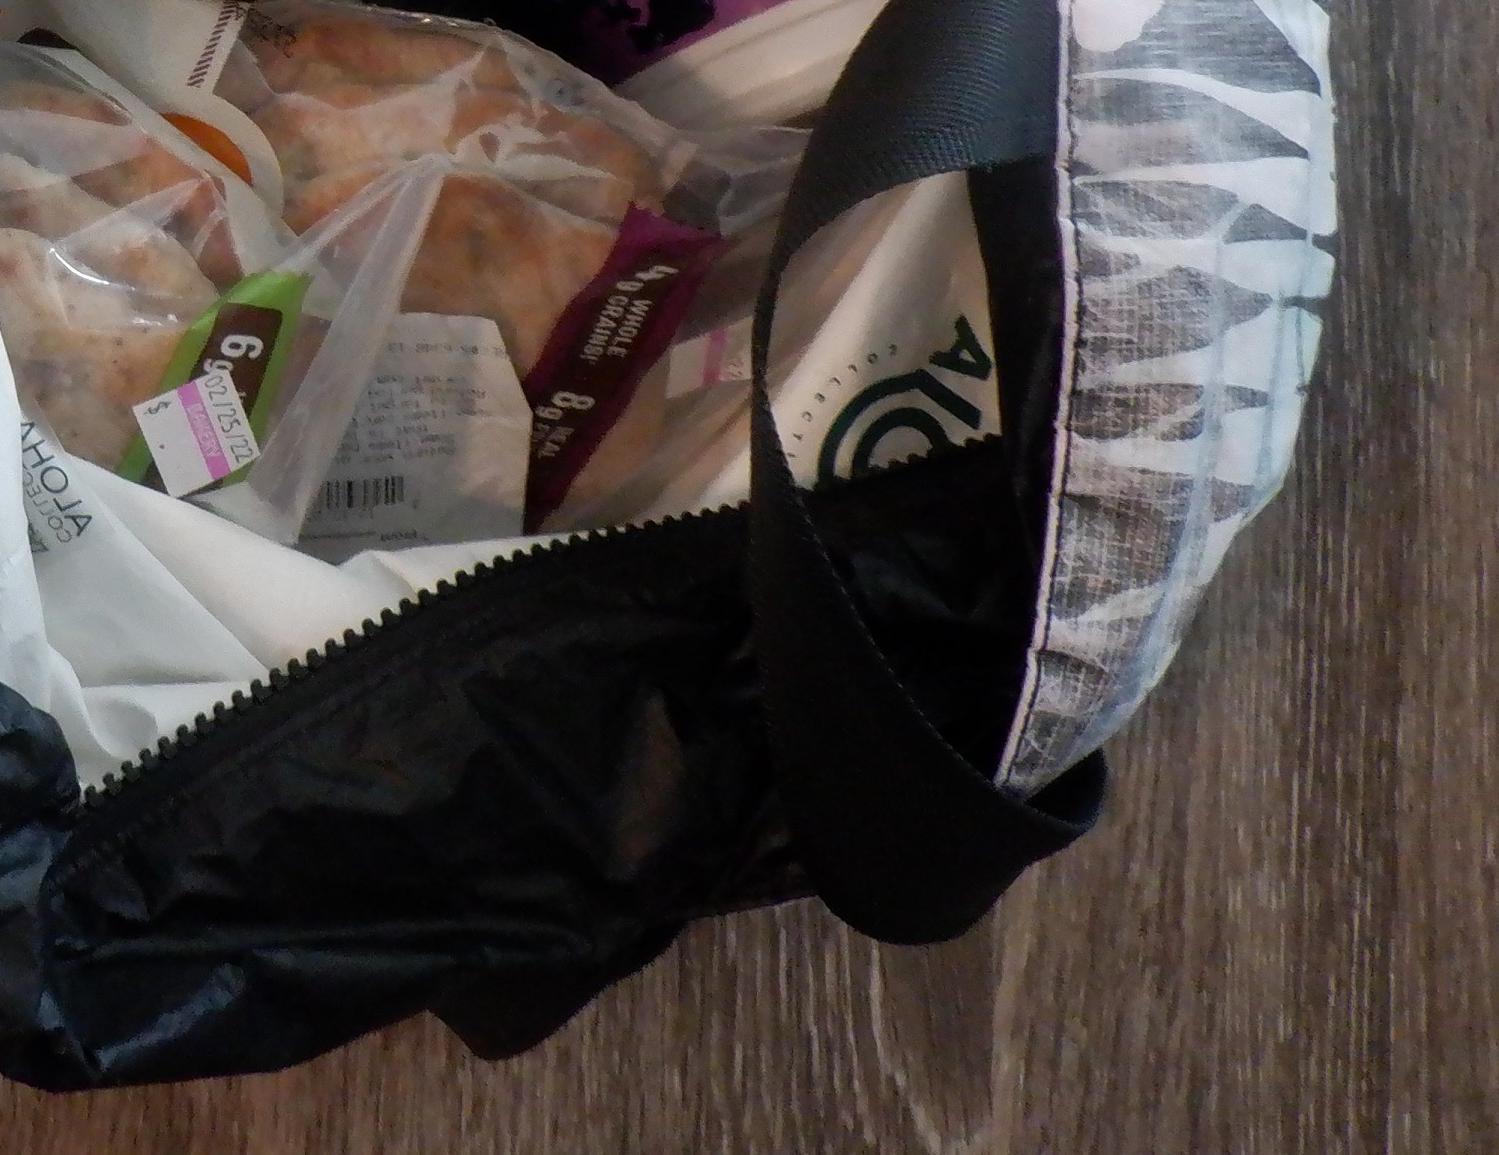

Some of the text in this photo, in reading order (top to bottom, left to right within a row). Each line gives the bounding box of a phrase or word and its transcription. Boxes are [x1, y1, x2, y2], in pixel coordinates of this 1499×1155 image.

[606, 299, 652, 358] WHOLE
[203, 371, 255, 464] 02/25/22
[537, 390, 596, 423] 8g
